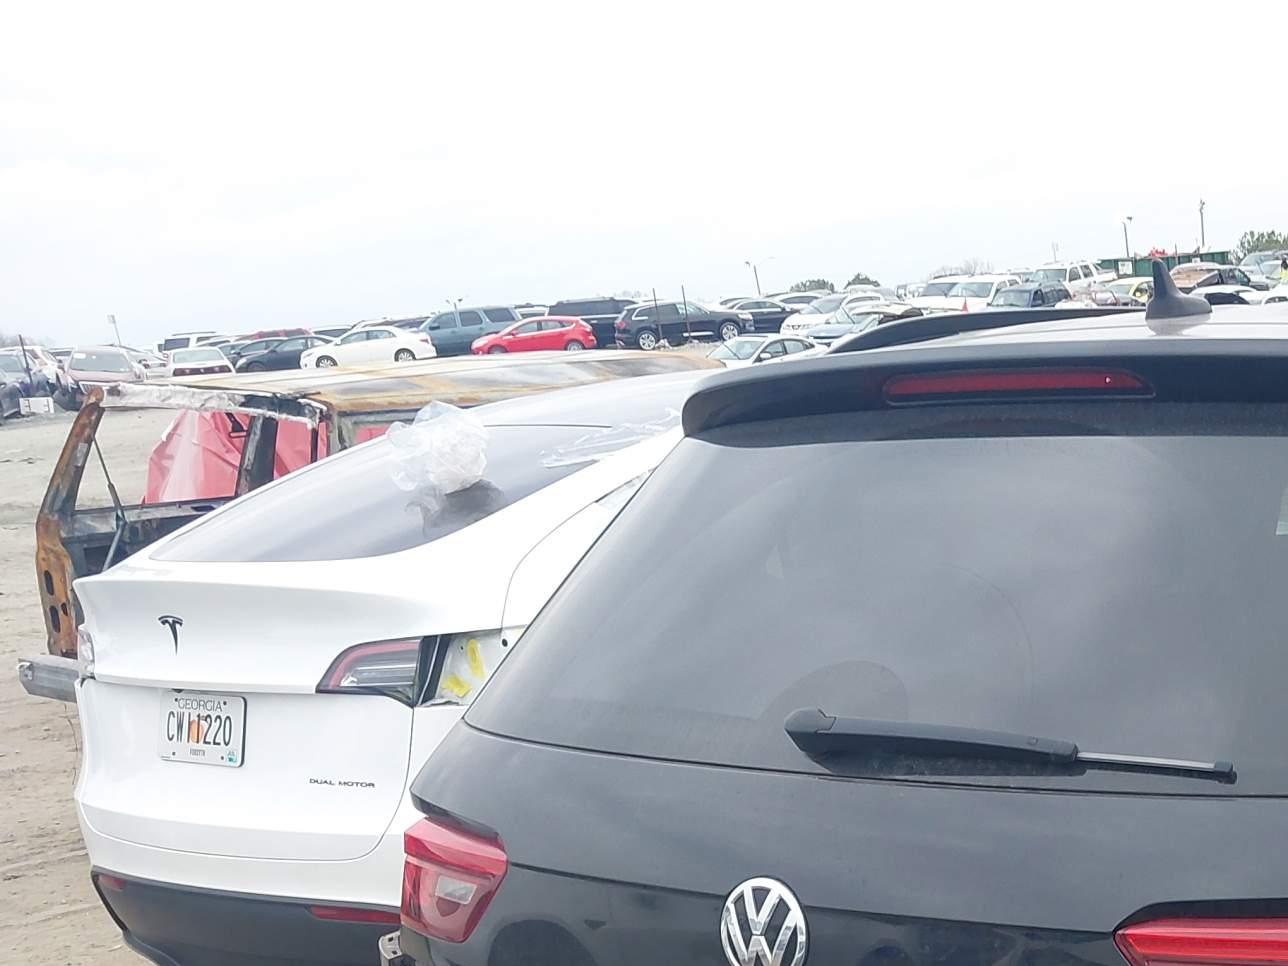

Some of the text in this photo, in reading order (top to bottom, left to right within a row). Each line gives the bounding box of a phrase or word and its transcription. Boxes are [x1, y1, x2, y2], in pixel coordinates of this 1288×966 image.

[177, 698, 222, 712] GEORGIA
[309, 778, 376, 788] DUAL MOTOR
